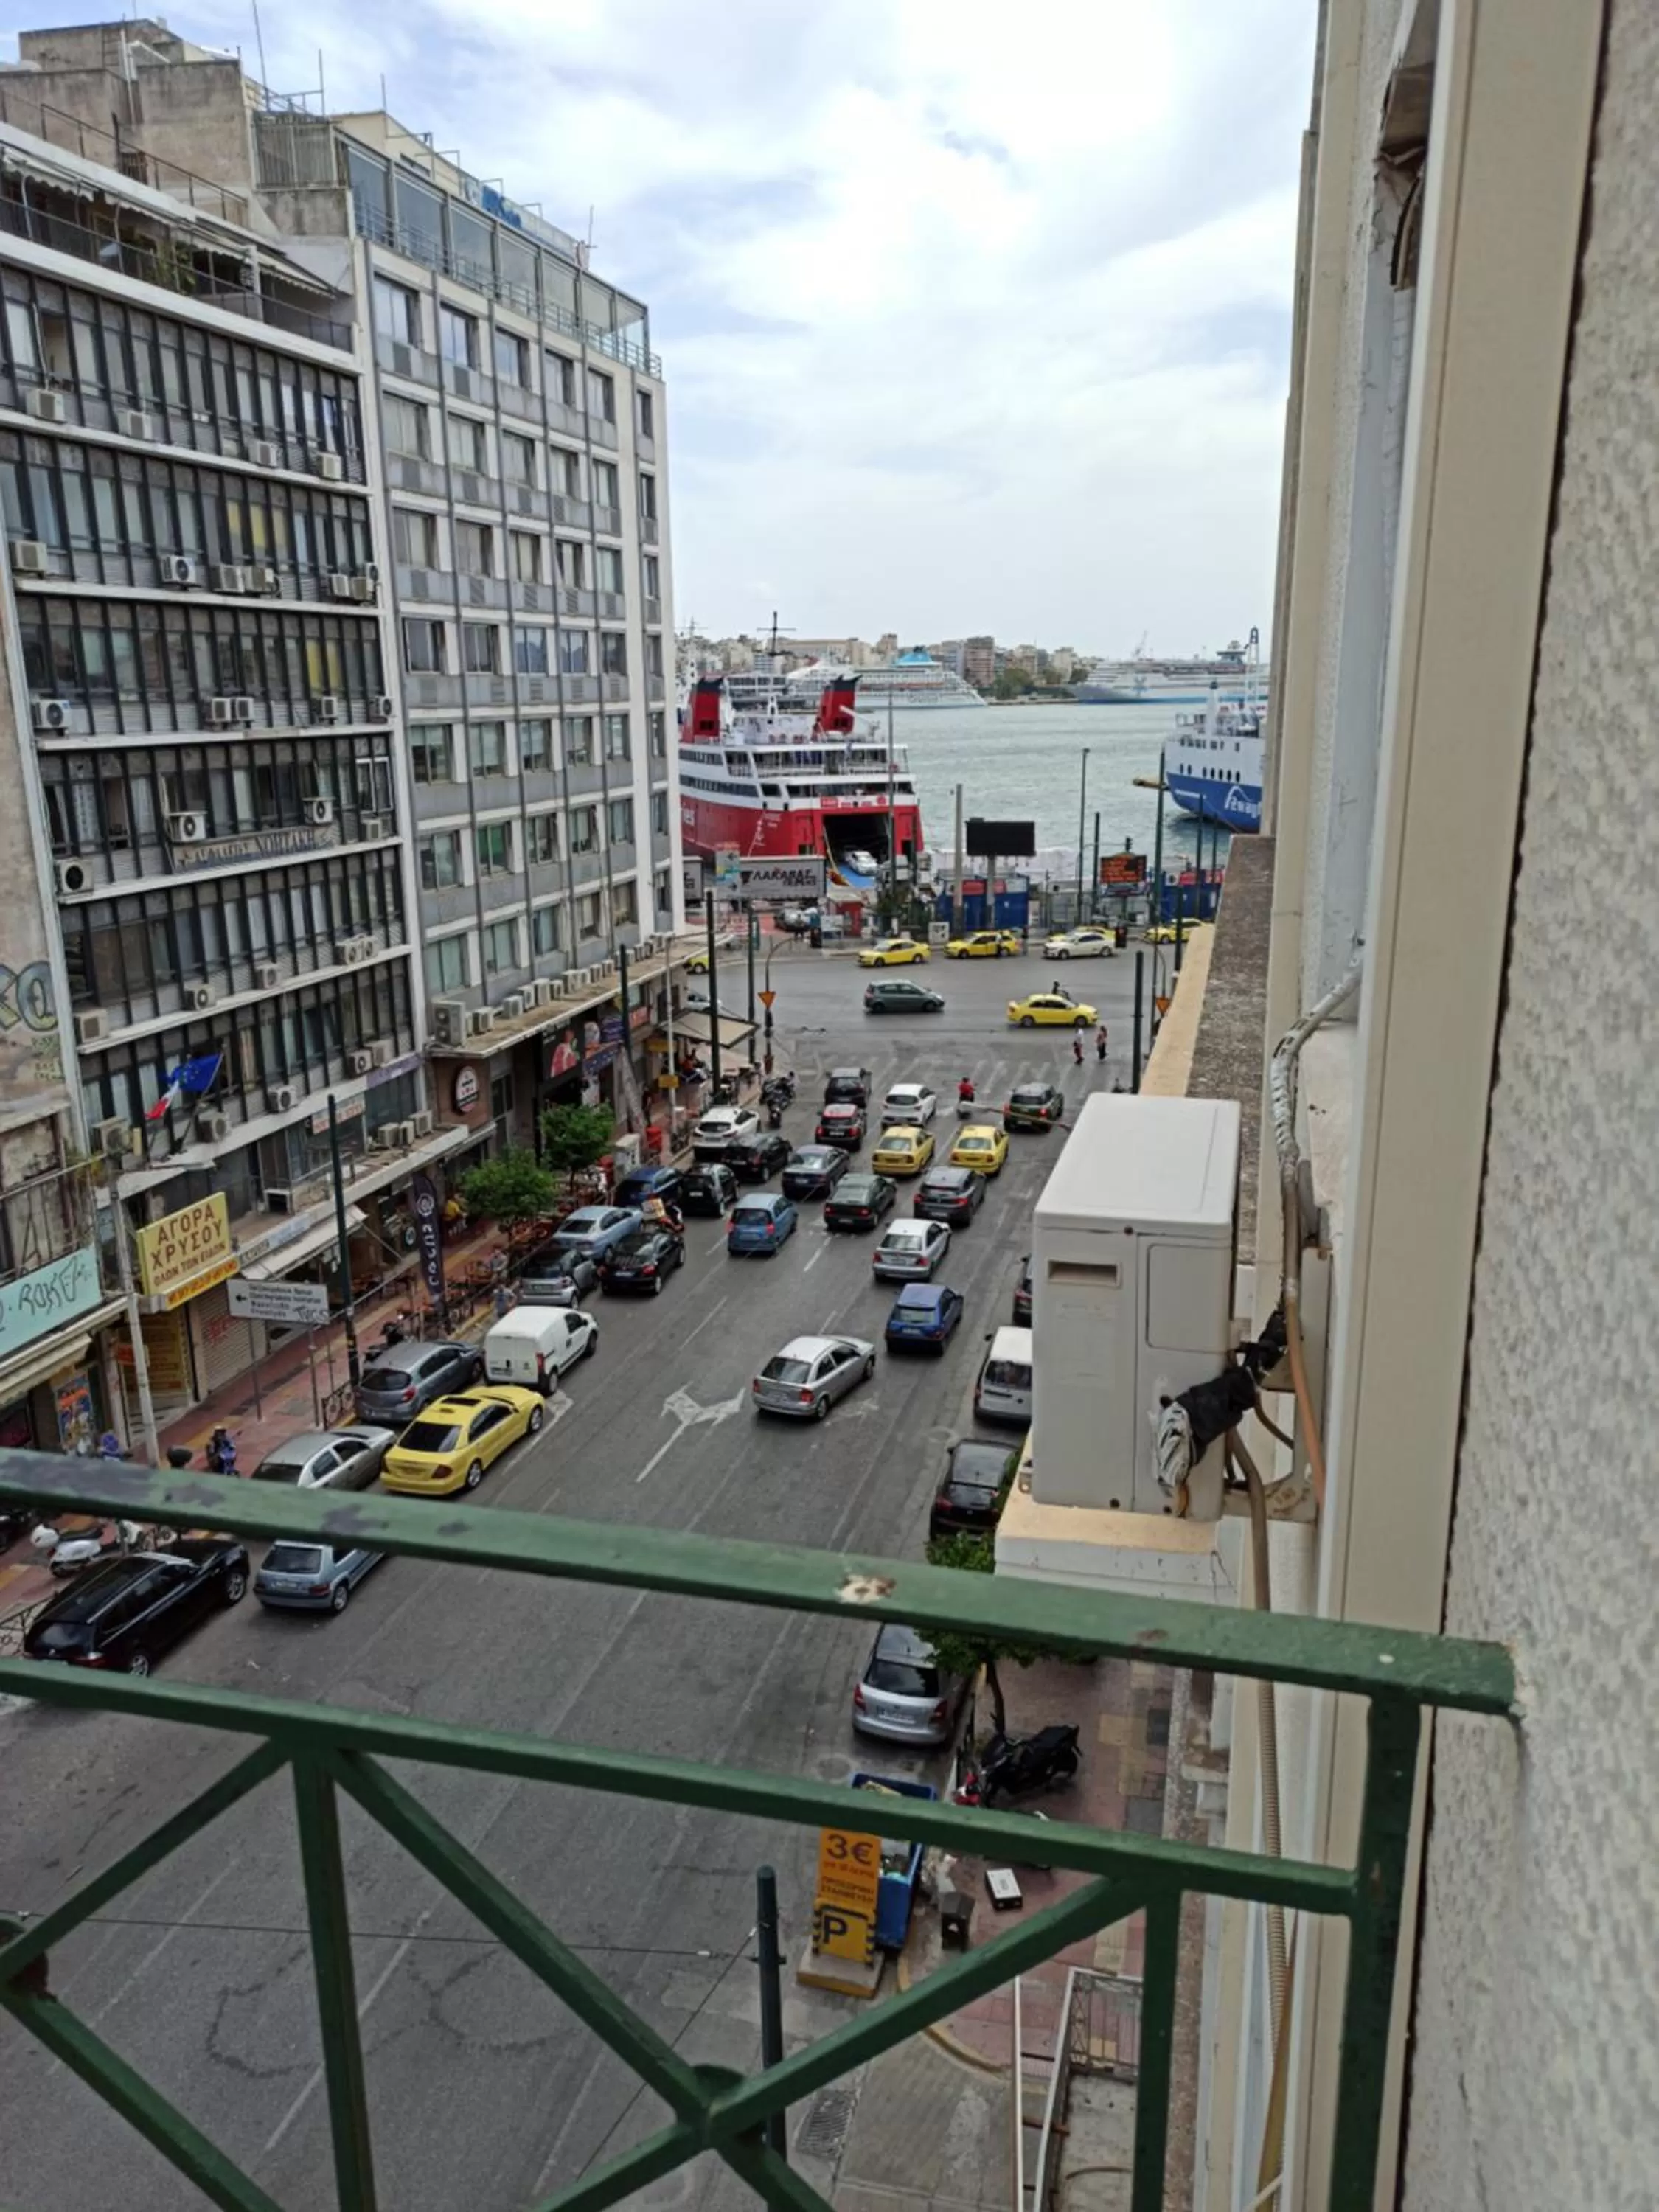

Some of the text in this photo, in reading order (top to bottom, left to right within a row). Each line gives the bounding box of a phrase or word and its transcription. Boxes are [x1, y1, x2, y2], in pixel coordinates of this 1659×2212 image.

[158, 1203, 215, 1245] ΑΓΟΡΑ
[150, 1219, 222, 1270] ΧΡΥΣΟΥ
[827, 1834, 874, 1866] 3€
[823, 1915, 848, 1944] P
